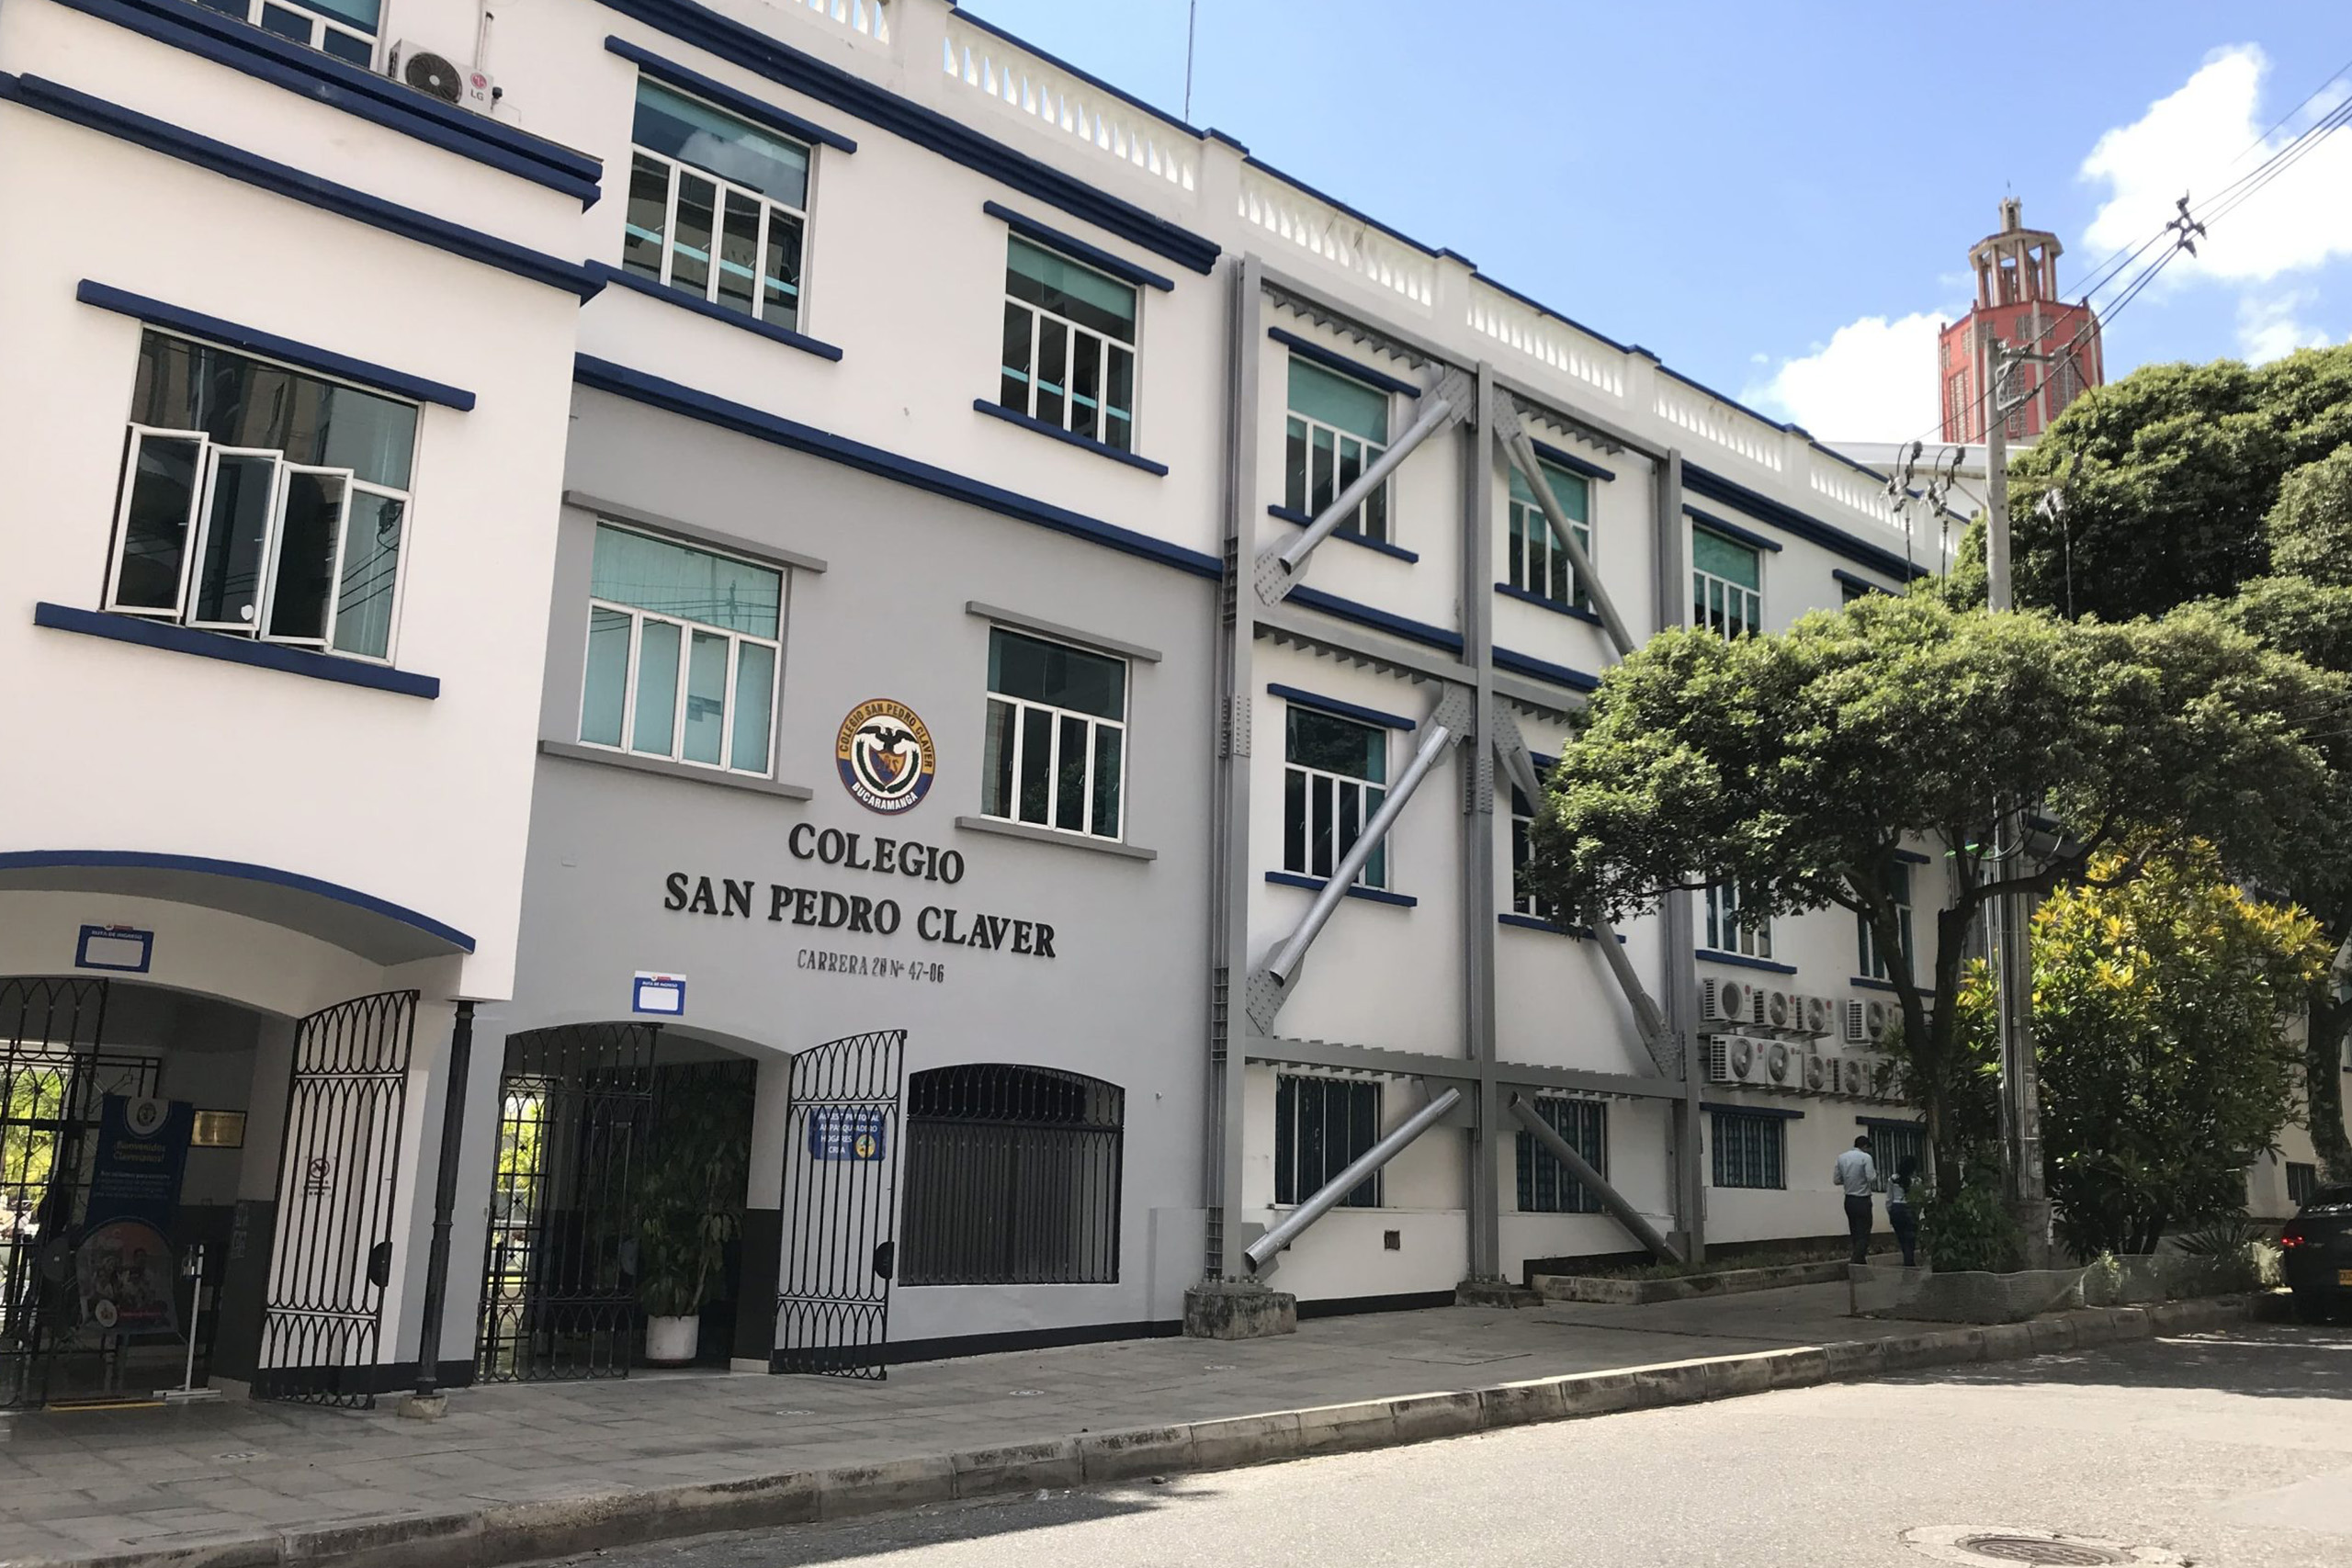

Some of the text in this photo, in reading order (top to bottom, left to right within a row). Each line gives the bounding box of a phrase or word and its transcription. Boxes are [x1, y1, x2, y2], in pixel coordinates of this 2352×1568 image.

[470, 88, 484, 101] LG
[839, 710, 864, 752] COLEGIO
[865, 703, 884, 716] SAN
[887, 704, 917, 727] PEDRO
[915, 726, 933, 768] CLAVER
[851, 781, 919, 810] BUCARAMANGA
[788, 823, 965, 884] COLEGIO
[664, 872, 1056, 958] SAN PEDRO CLAVER
[797, 949, 868, 976] CARRERA
[909, 961, 944, 983] 47-06
